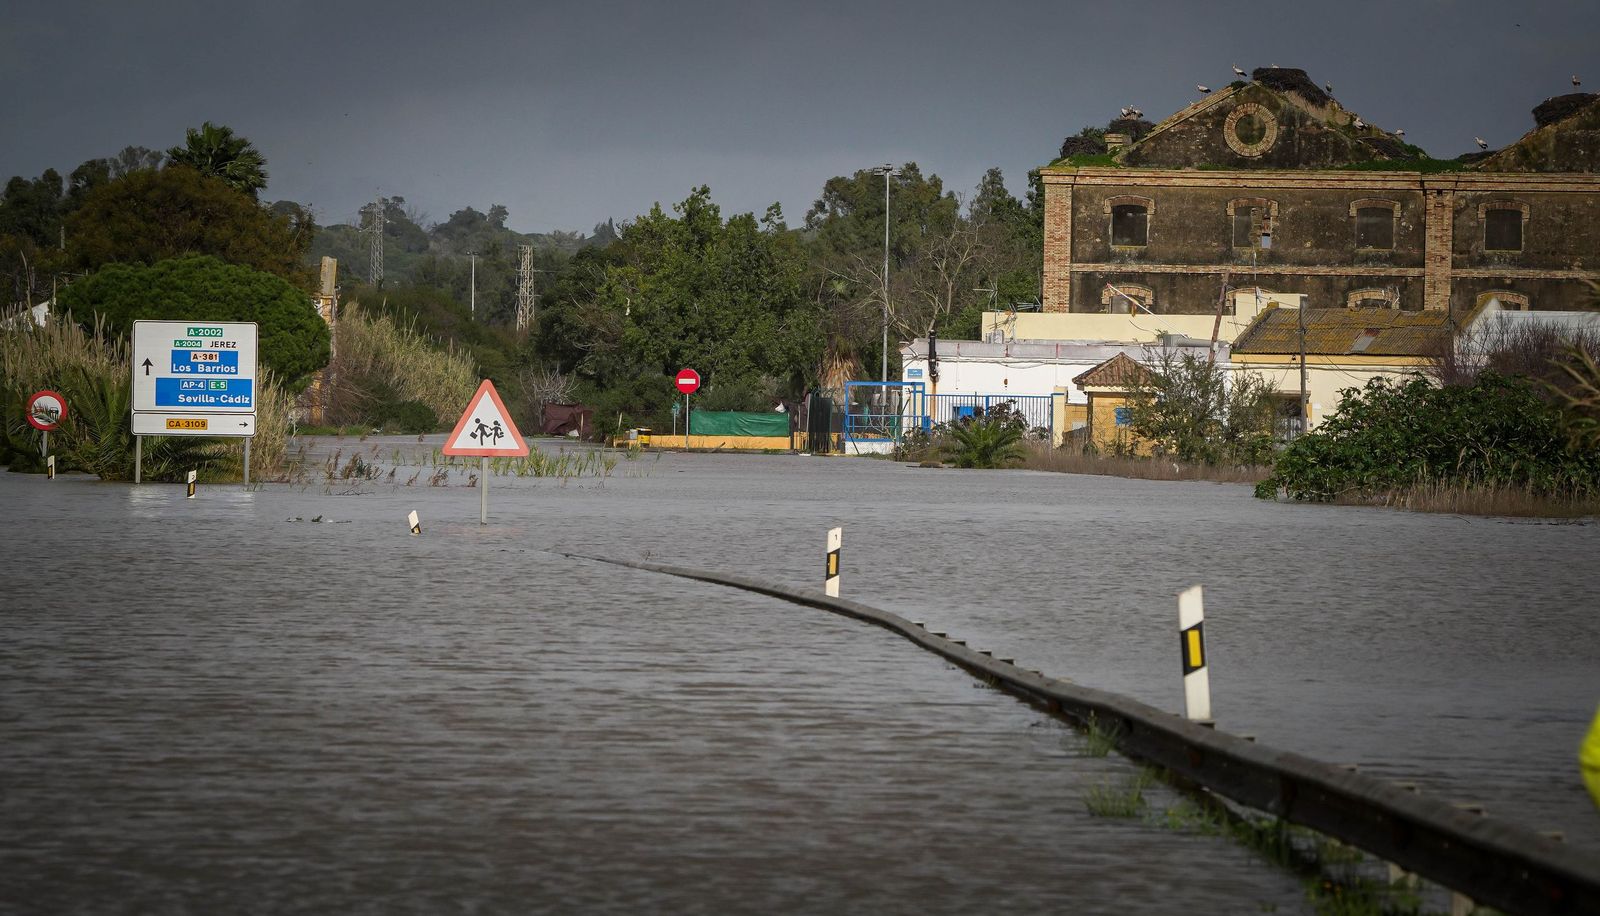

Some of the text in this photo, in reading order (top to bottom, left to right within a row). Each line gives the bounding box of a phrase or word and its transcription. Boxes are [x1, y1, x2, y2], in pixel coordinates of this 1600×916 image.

[192, 353, 218, 361] A-381
[172, 364, 236, 373] Los Barrios
[182, 381, 226, 389] AP-4 E-5
[178, 394, 250, 404] Sevilla-Cádiz
[168, 420, 206, 428] CA-3109
